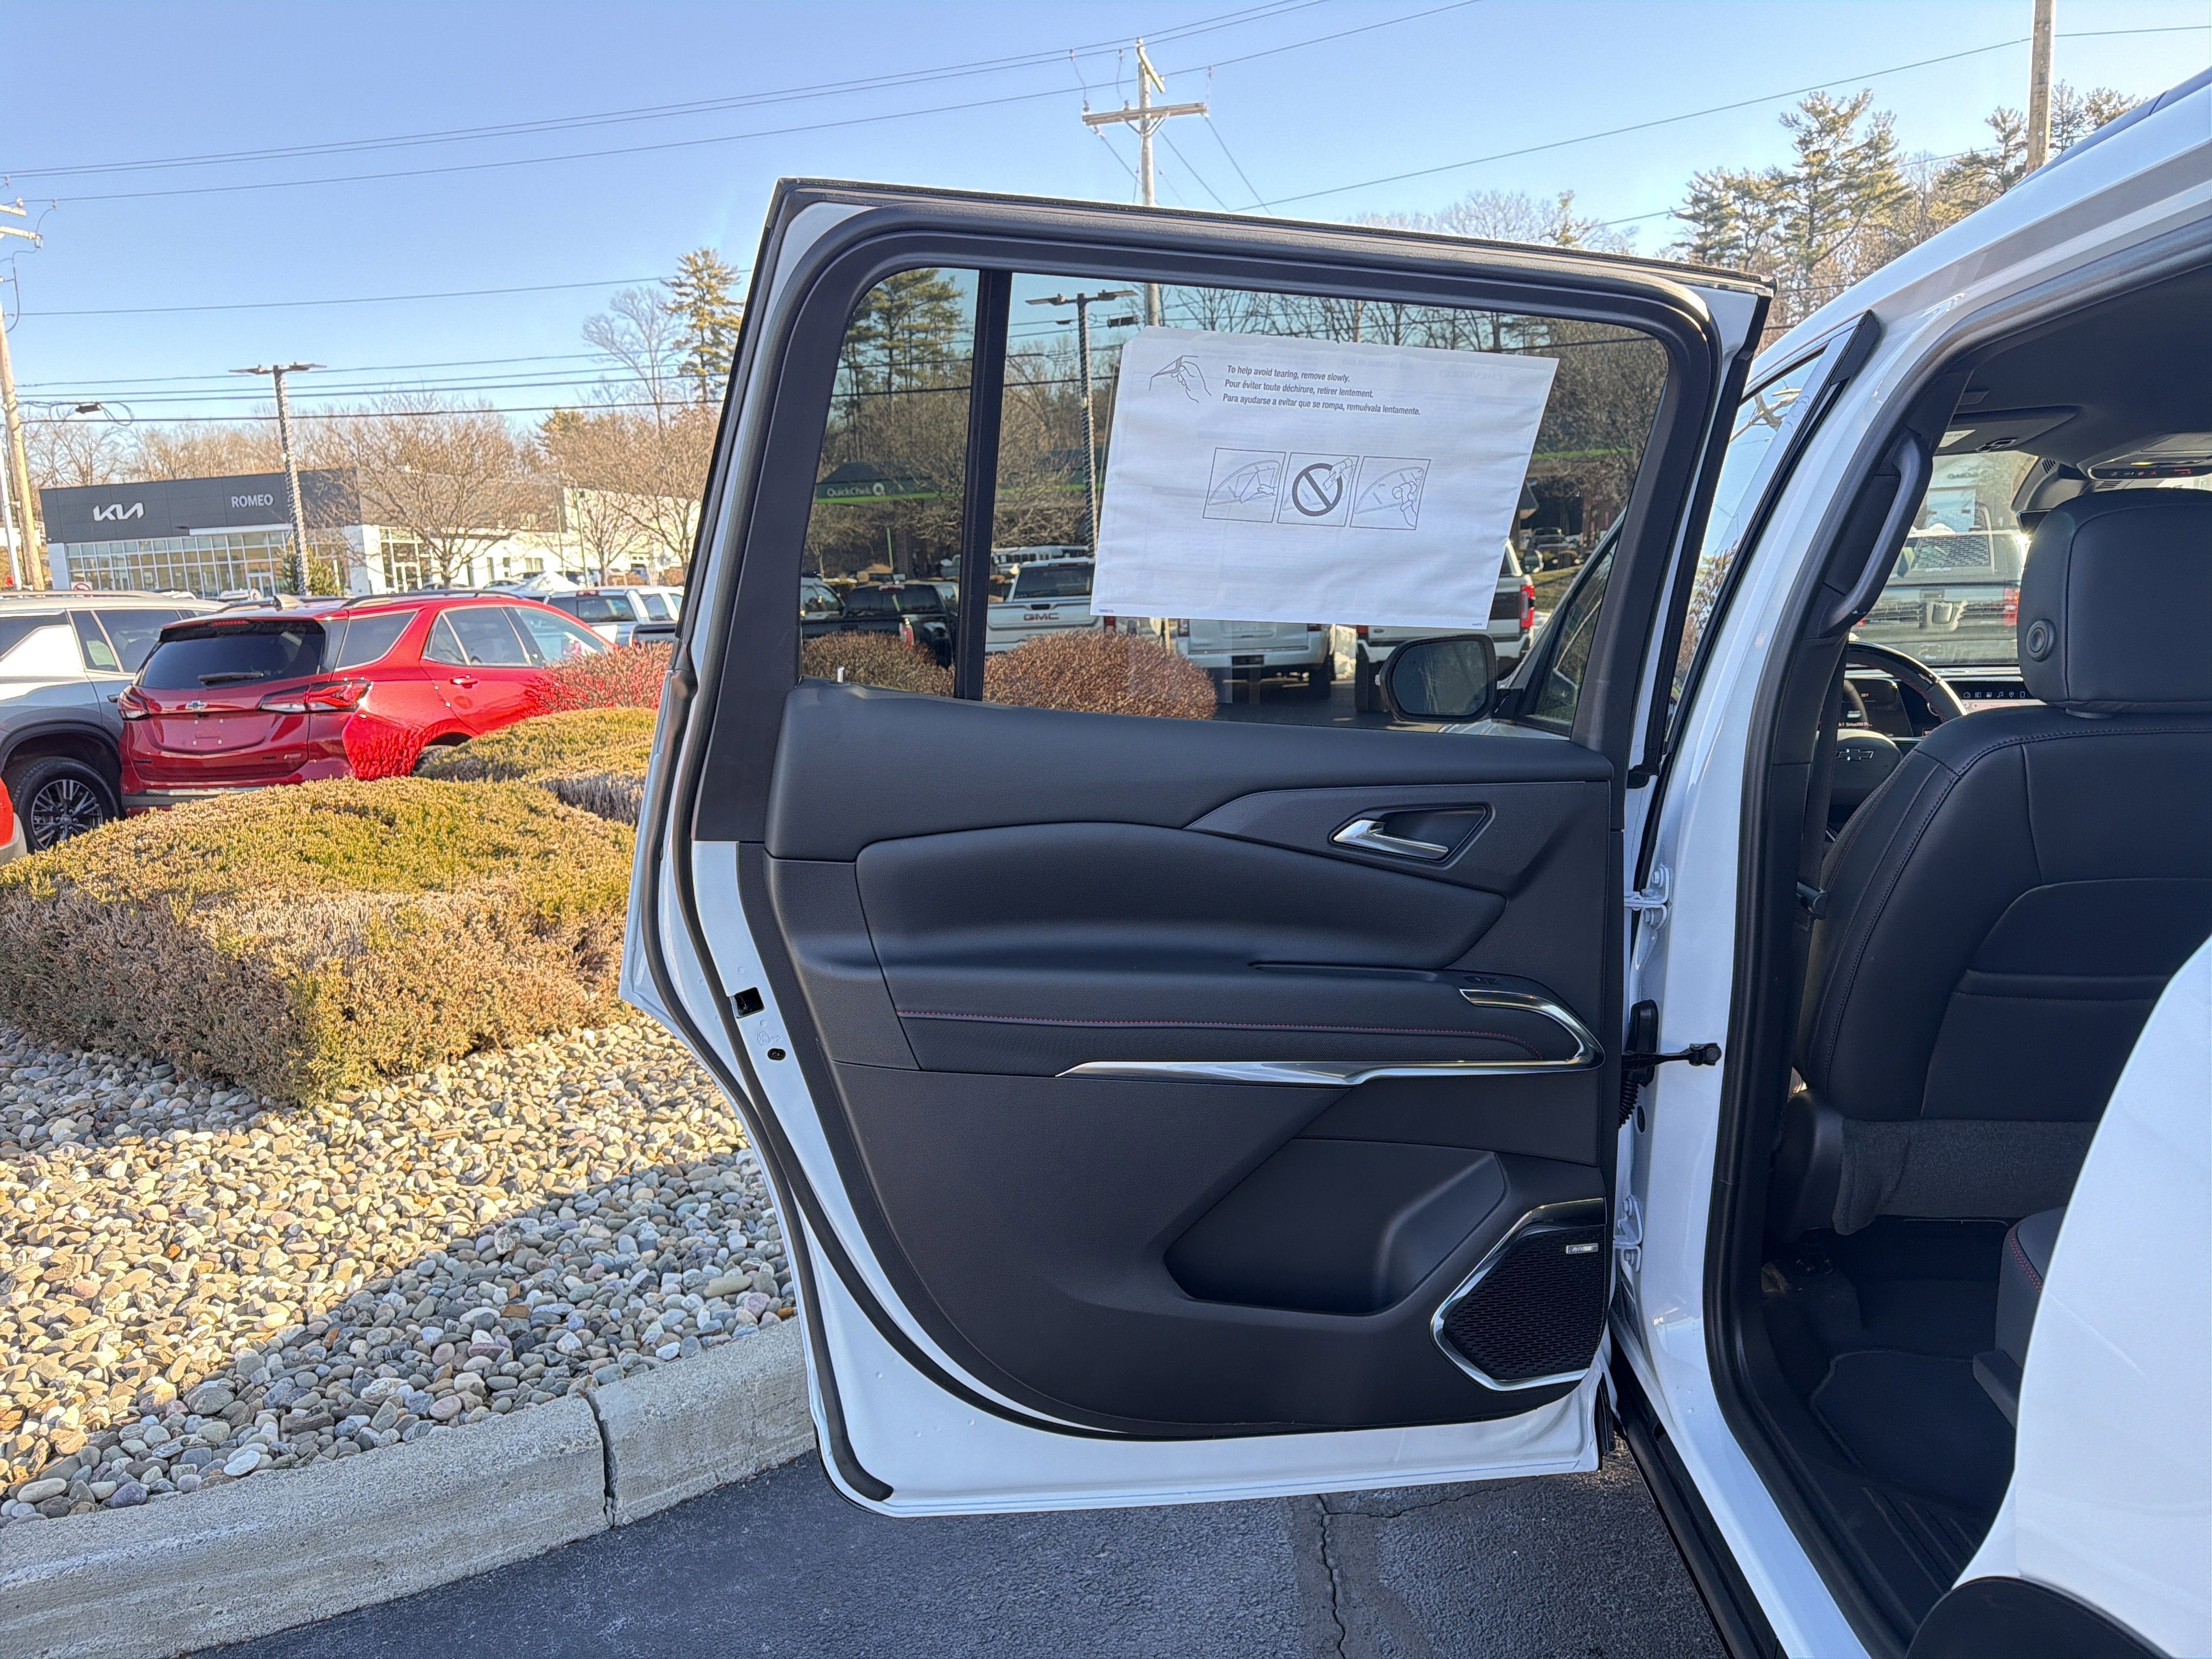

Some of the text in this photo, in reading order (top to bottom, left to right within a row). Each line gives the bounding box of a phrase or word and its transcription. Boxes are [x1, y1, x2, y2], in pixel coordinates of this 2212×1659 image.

[1227, 365, 1235, 373] To
[1237, 366, 1252, 376] help
[1254, 368, 1272, 376] avoid
[1274, 369, 1299, 380] tearing,
[1327, 373, 1350, 383] slowly.
[1224, 379, 1373, 398] Pour éviter toute déchirure, retirer lentement.
[1222, 393, 1238, 402] Para
[1240, 396, 1271, 405] ayudarse
[1278, 398, 1297, 407] evitar
[1322, 402, 1345, 411] rompa,
[1347, 403, 1381, 412] remuévala
[1383, 405, 1420, 415] lentamente.
[231, 494, 274, 508] ROMEO
[93, 502, 145, 521] KIA
